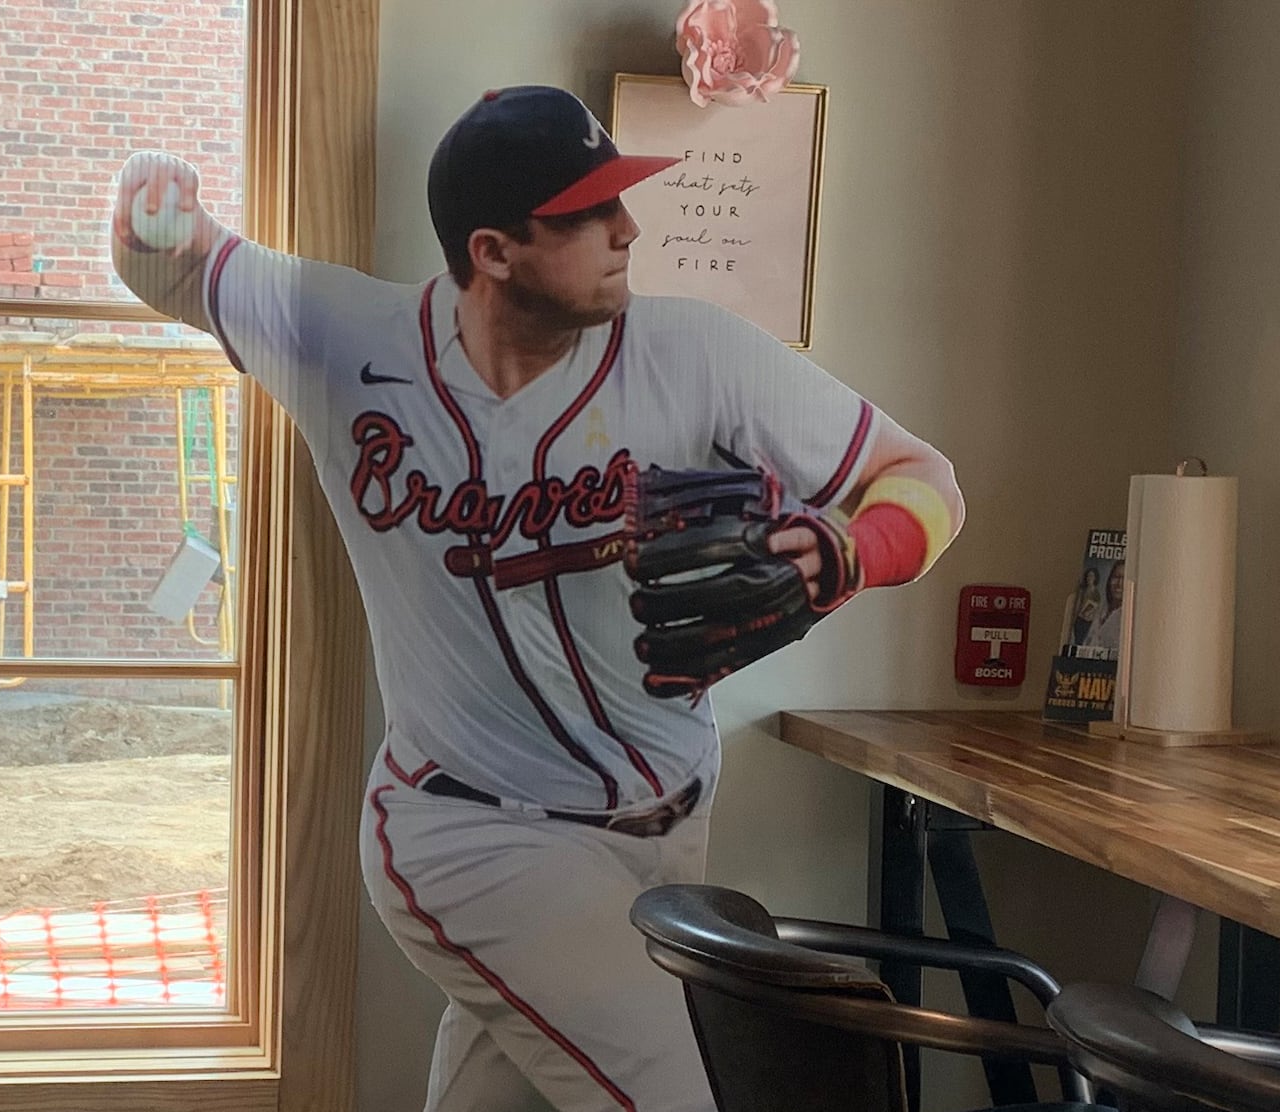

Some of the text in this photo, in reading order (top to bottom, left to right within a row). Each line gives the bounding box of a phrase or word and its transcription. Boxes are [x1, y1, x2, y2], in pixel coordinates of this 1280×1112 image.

[684, 150, 743, 164] FIND
[663, 173, 760, 197] what sets
[680, 204, 740, 218] YOUR
[662, 229, 752, 247] soul on
[677, 257, 737, 272] FIRE
[350, 411, 630, 550] Braves
[971, 595, 1026, 610] FIRE FIRE
[984, 630, 1009, 641] PULL
[975, 668, 1012, 679] BOSCH
